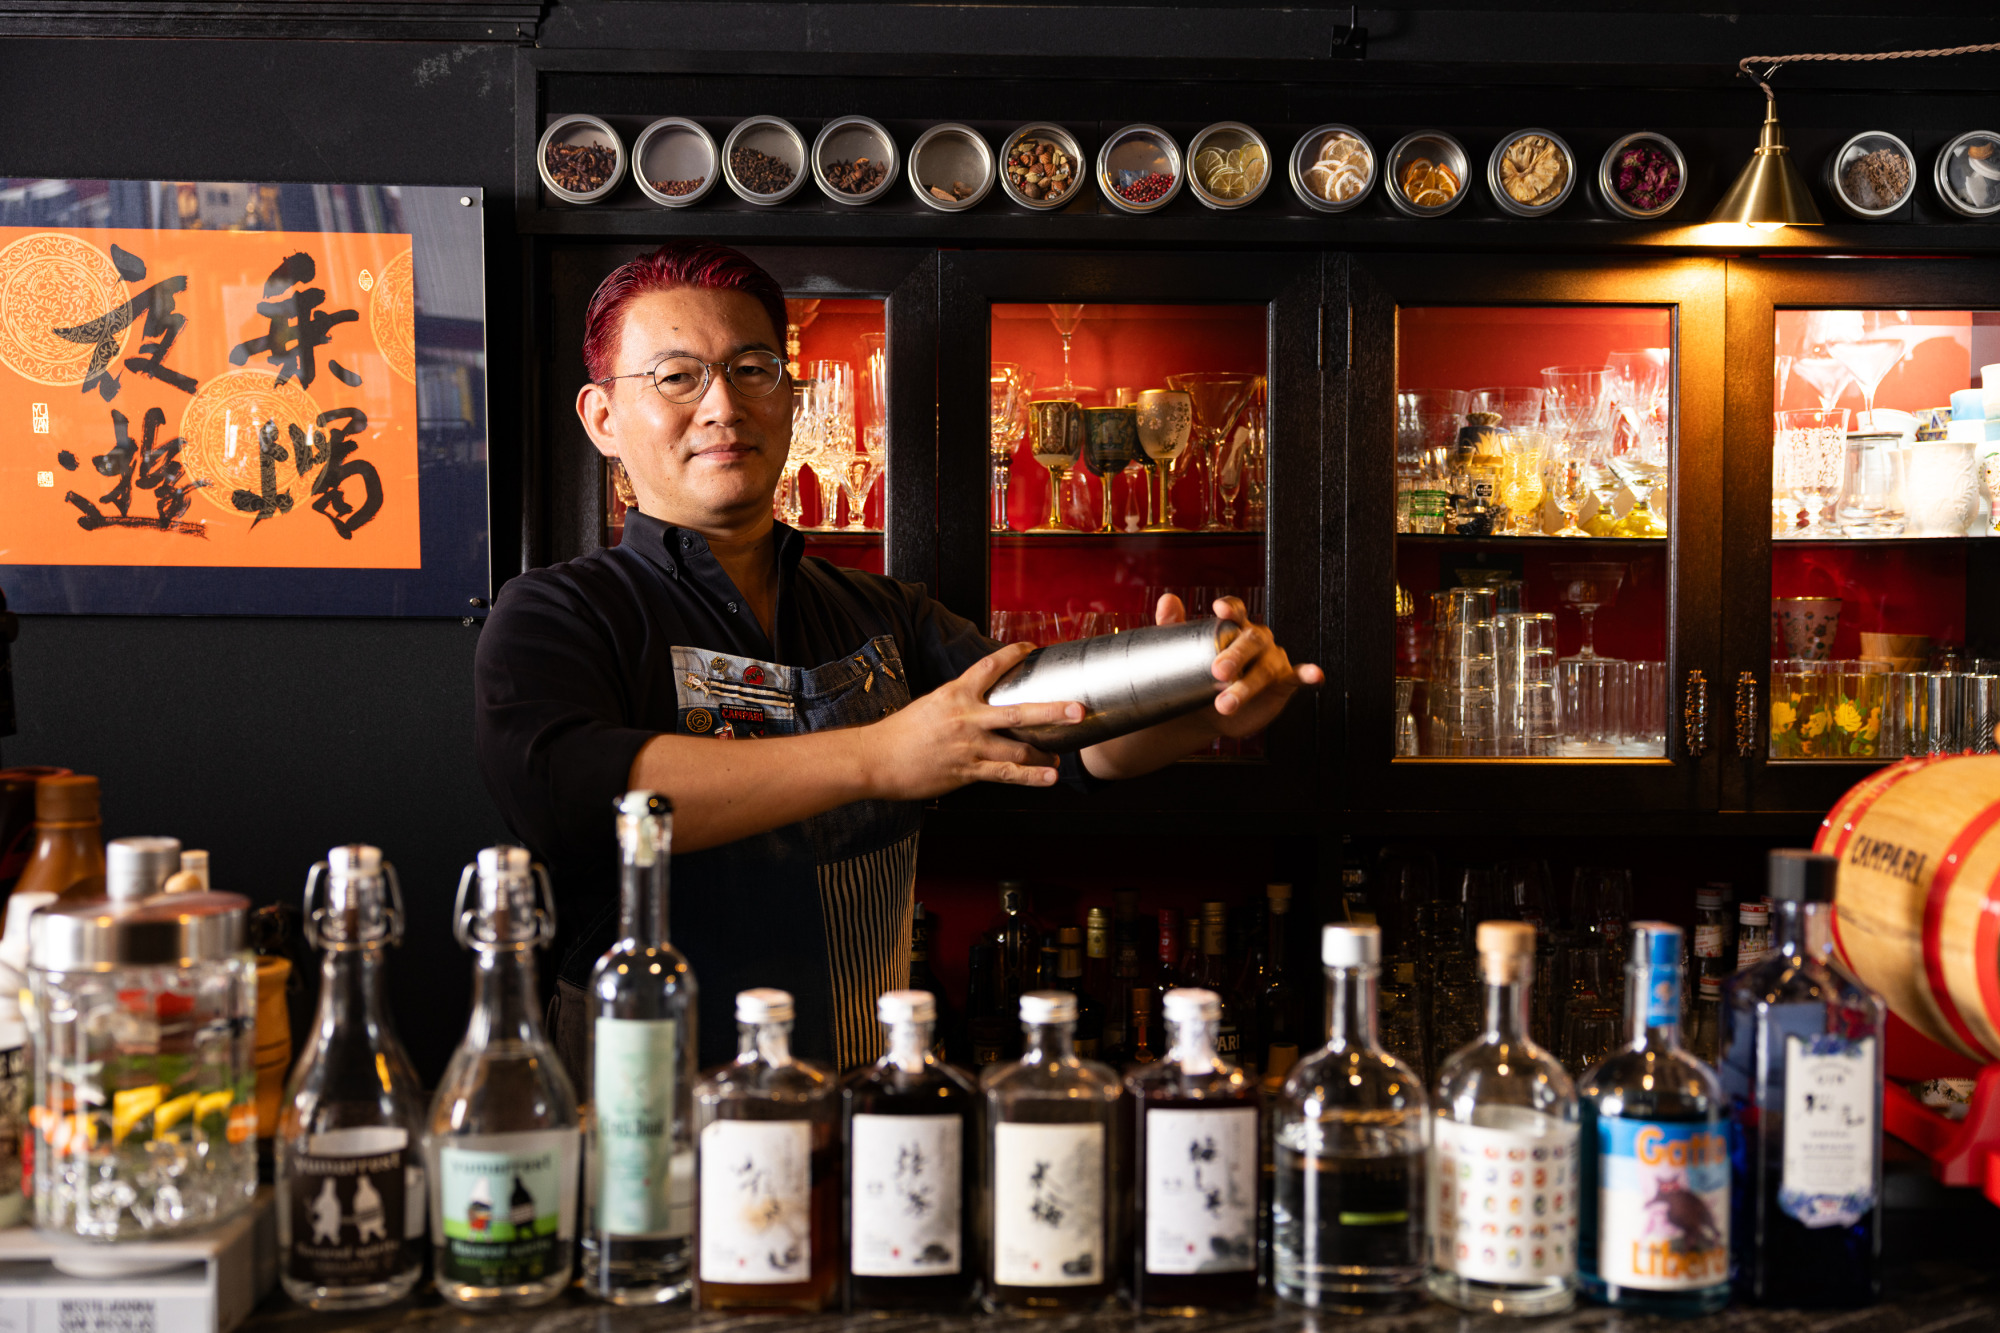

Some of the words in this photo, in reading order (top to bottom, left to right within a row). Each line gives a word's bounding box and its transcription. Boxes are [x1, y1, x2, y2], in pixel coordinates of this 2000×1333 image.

[721, 708, 764, 722] CAMPARI
[1850, 833, 1928, 885] CAMPARI
[1636, 1125, 1727, 1167] Gatto
